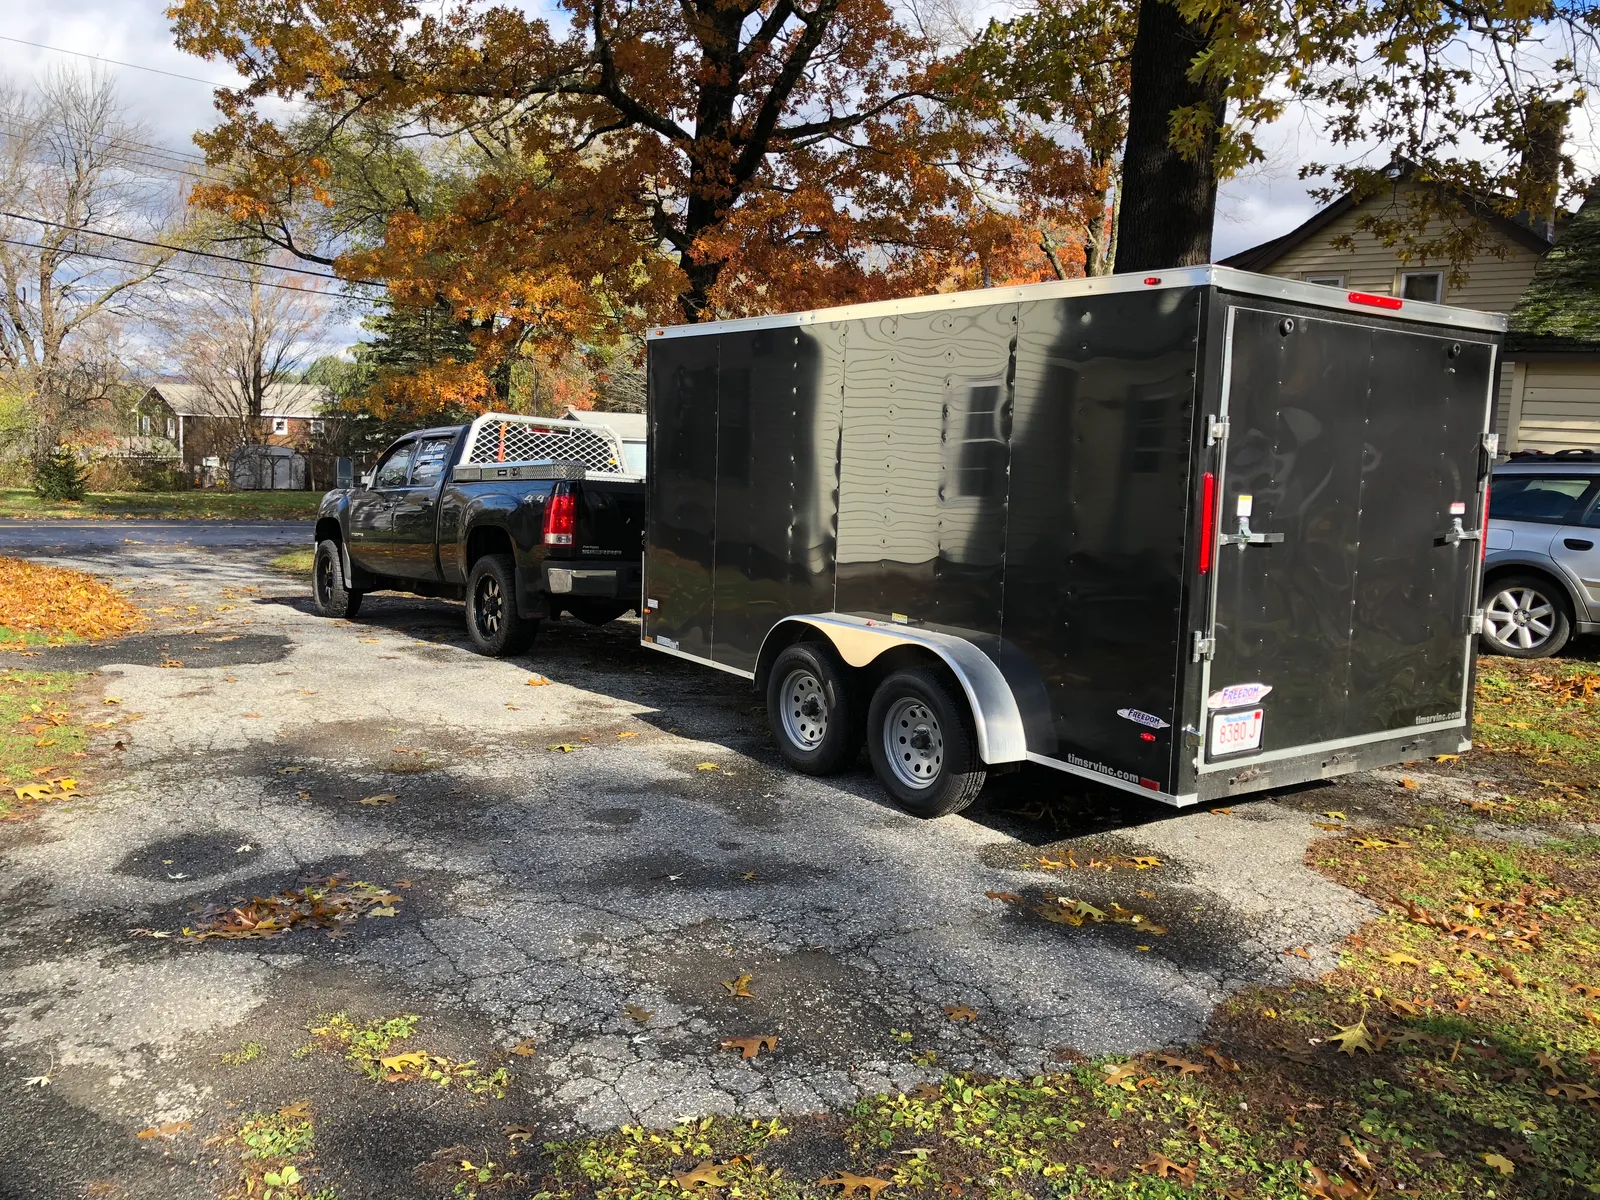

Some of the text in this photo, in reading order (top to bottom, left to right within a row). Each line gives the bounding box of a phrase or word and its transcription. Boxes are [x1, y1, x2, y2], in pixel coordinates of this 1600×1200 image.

[1222, 686, 1260, 703] FREEDOM
[1127, 708, 1161, 725] FREEDOM
[1415, 711, 1461, 725] timsrvinc.com
[1219, 718, 1257, 744] 8380 J
[1067, 753, 1139, 783] timsrvinc.com
